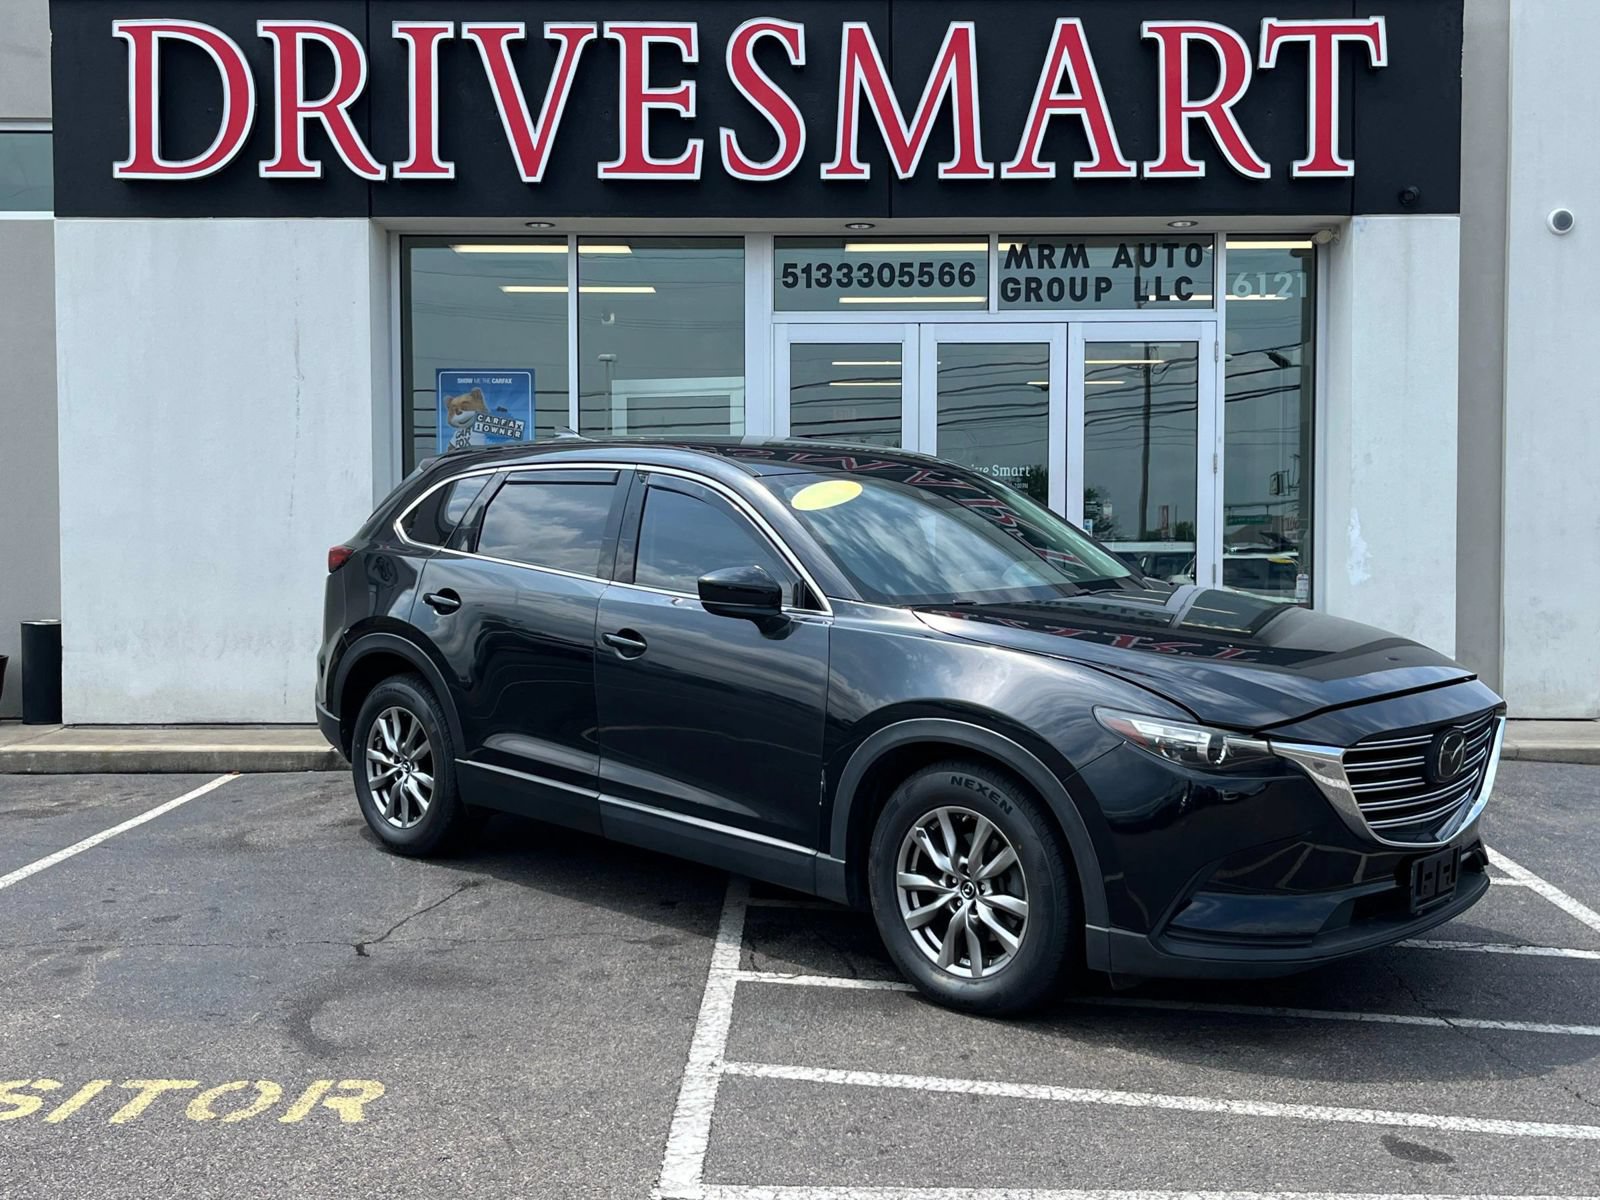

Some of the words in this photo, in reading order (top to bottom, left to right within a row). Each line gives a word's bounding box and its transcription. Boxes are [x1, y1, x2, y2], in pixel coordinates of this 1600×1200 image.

[111, 15, 1389, 183] DRIVESMART
[1004, 243, 1090, 269] MRM
[1112, 242, 1204, 269] AUTO
[782, 262, 976, 289] 5133305566
[1000, 276, 1113, 303] GROUP
[1134, 275, 1194, 302] LLC
[1232, 271, 1307, 298] 6121
[477, 414, 524, 431] CARFAX
[483, 424, 521, 439] OWNER
[992, 464, 1031, 477] Smart
[950, 775, 1014, 815] NEXEN
[0, 1078, 385, 1124] SITOR
